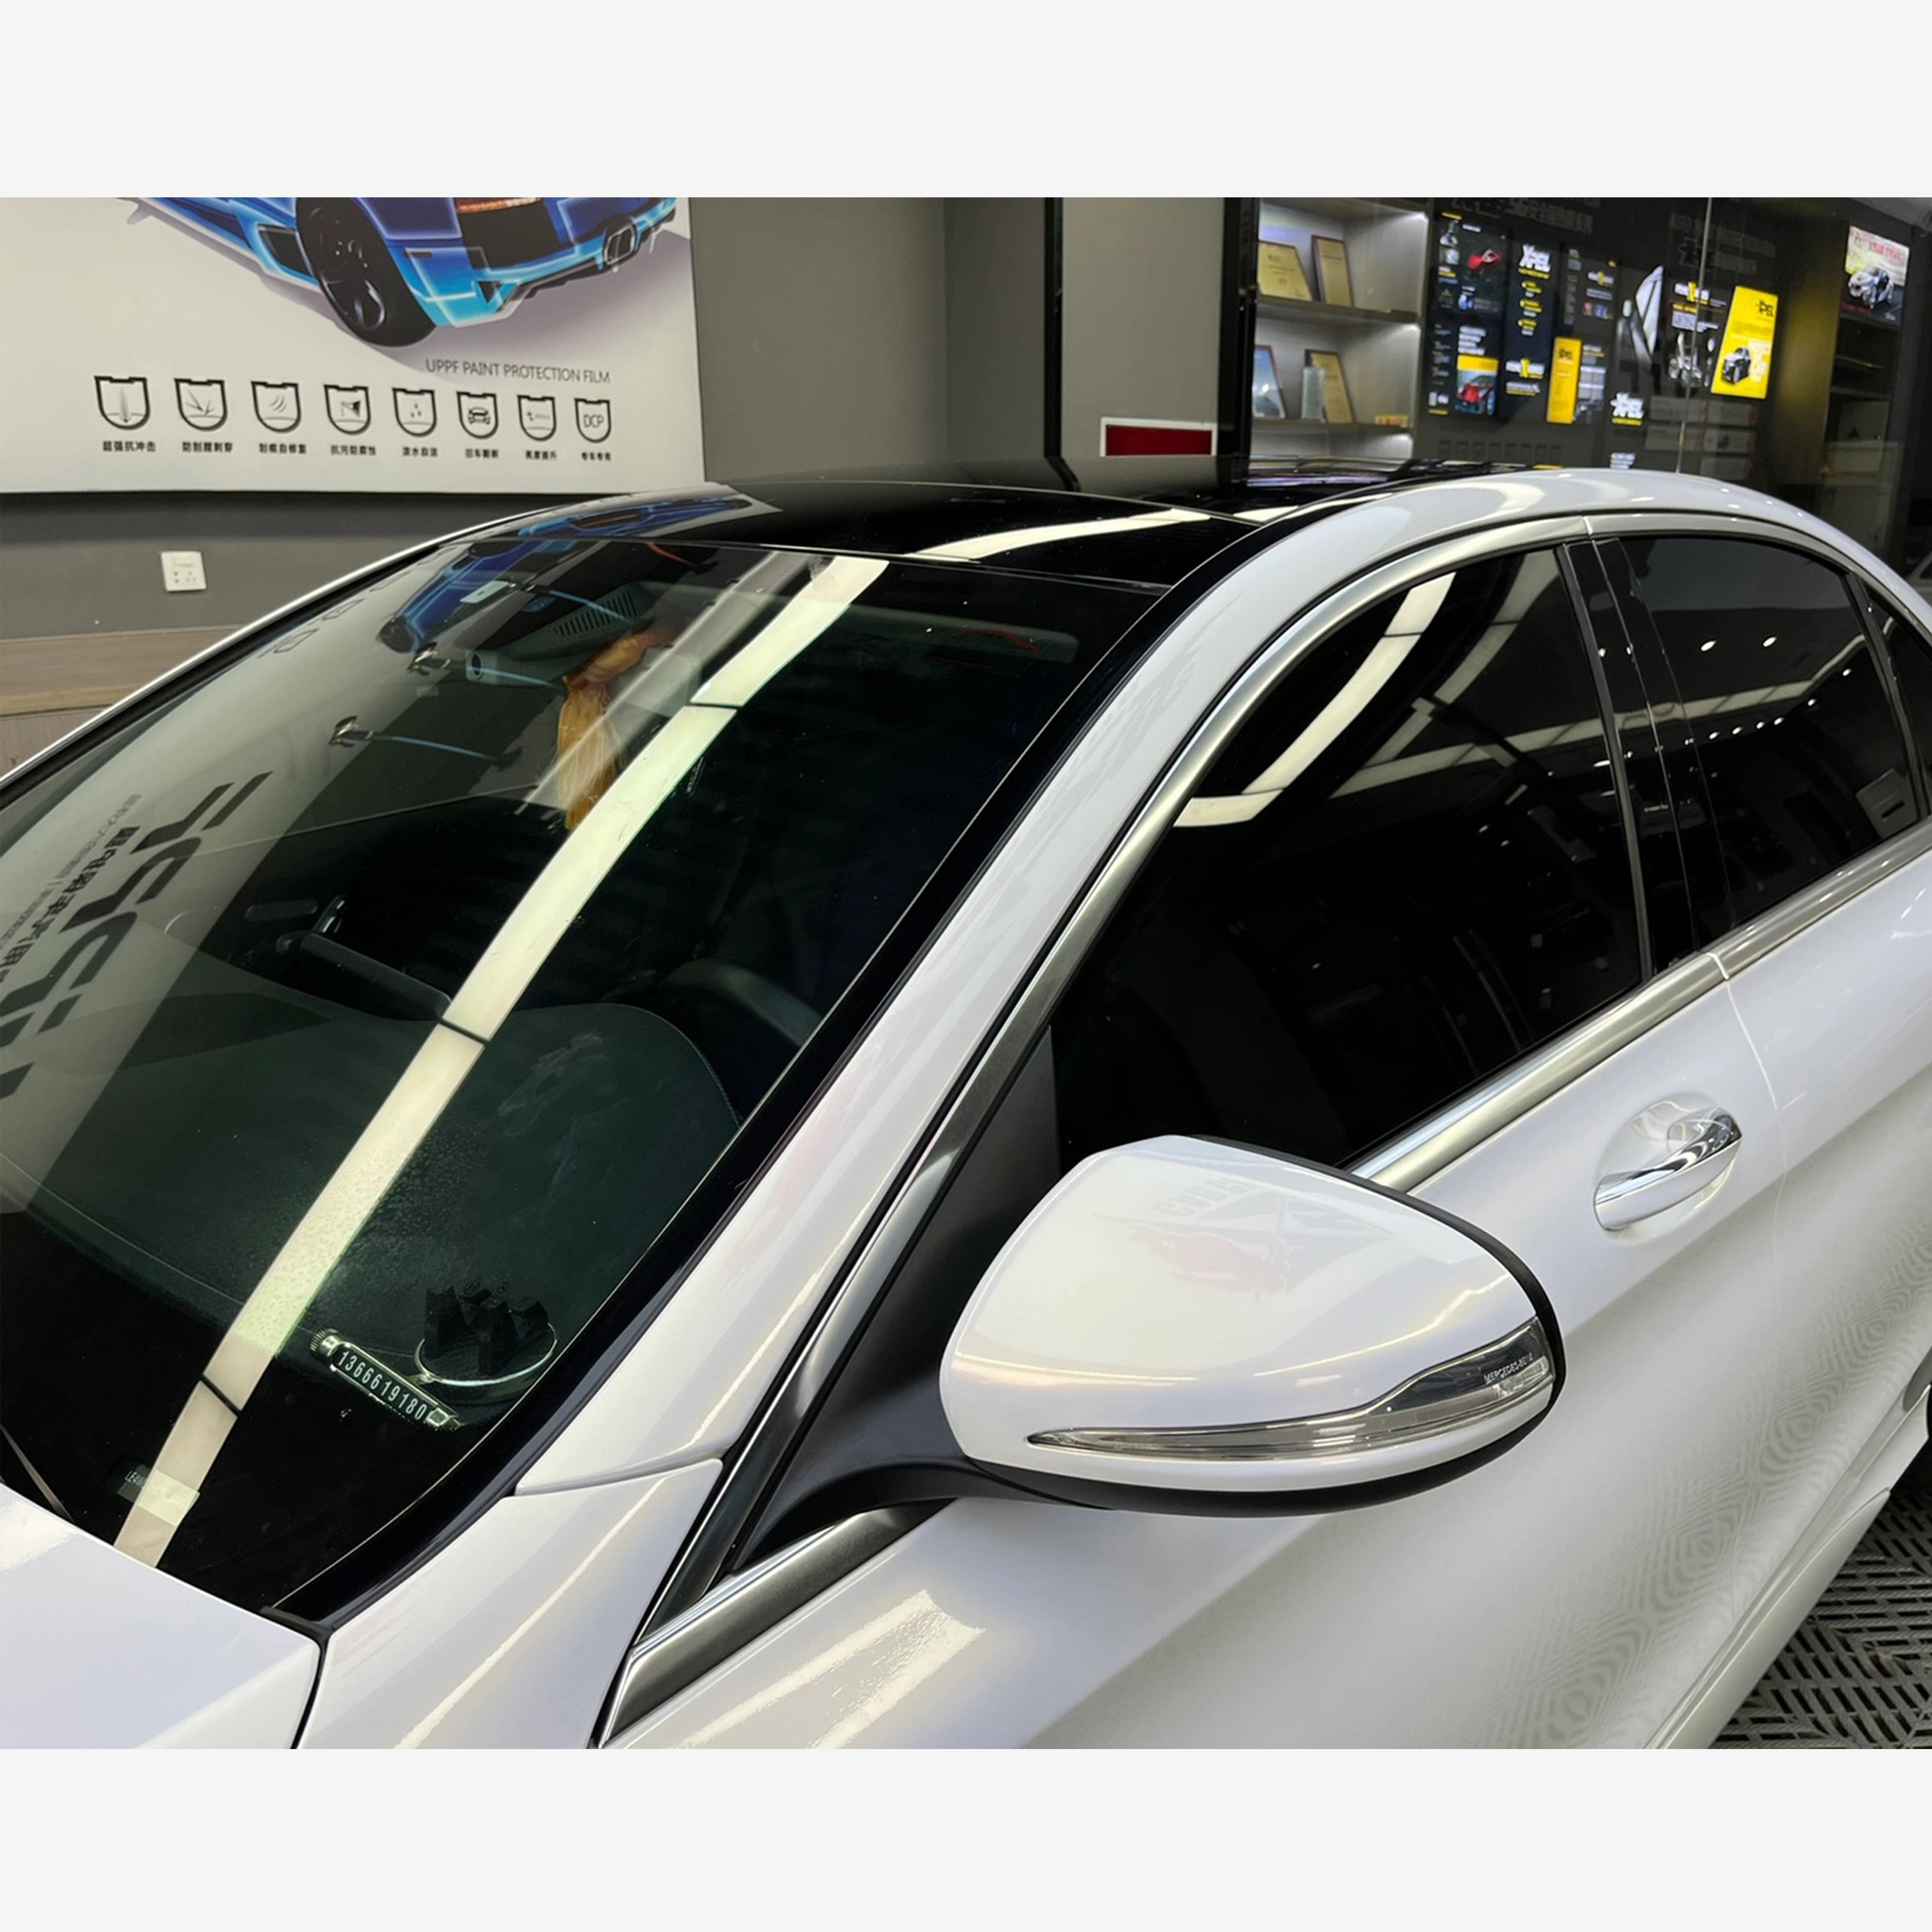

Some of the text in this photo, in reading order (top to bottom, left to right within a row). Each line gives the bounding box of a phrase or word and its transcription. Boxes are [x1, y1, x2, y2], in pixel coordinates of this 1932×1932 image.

[425, 359, 611, 384] UPPF PAINT PROTECTION FILM
[583, 414, 605, 428] DCP
